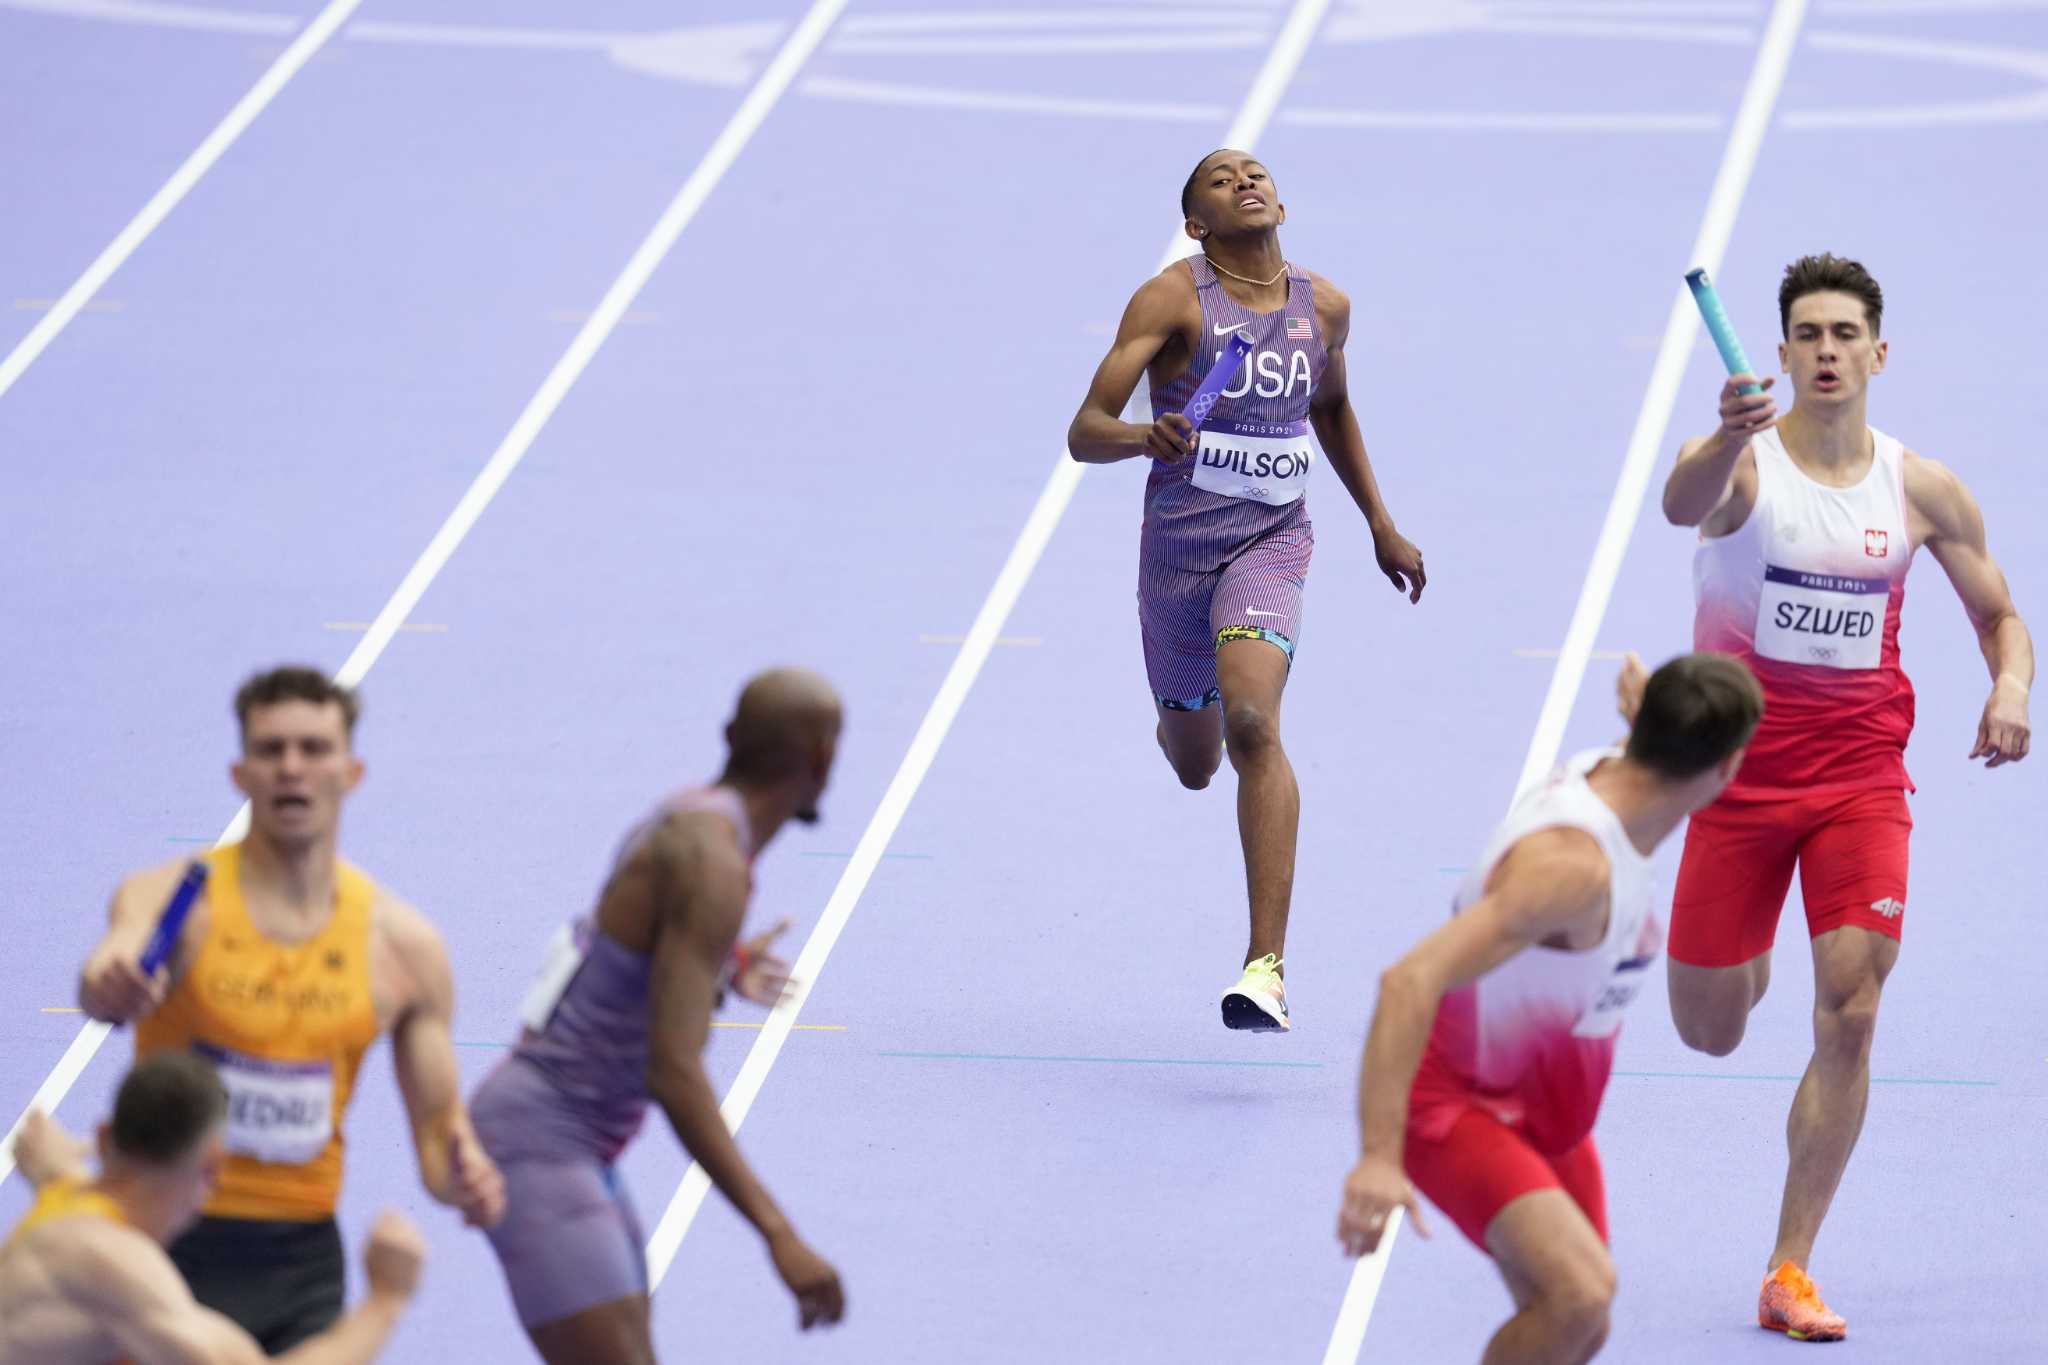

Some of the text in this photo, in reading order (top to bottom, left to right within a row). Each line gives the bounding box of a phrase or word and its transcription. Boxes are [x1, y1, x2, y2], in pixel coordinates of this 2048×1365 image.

[1235, 424, 1266, 434] PARIS
[1202, 448, 1310, 479] WILSON
[1801, 575, 1834, 589] PARIS
[1775, 602, 1874, 638] SZWED
[1871, 896, 1904, 918] 4F
